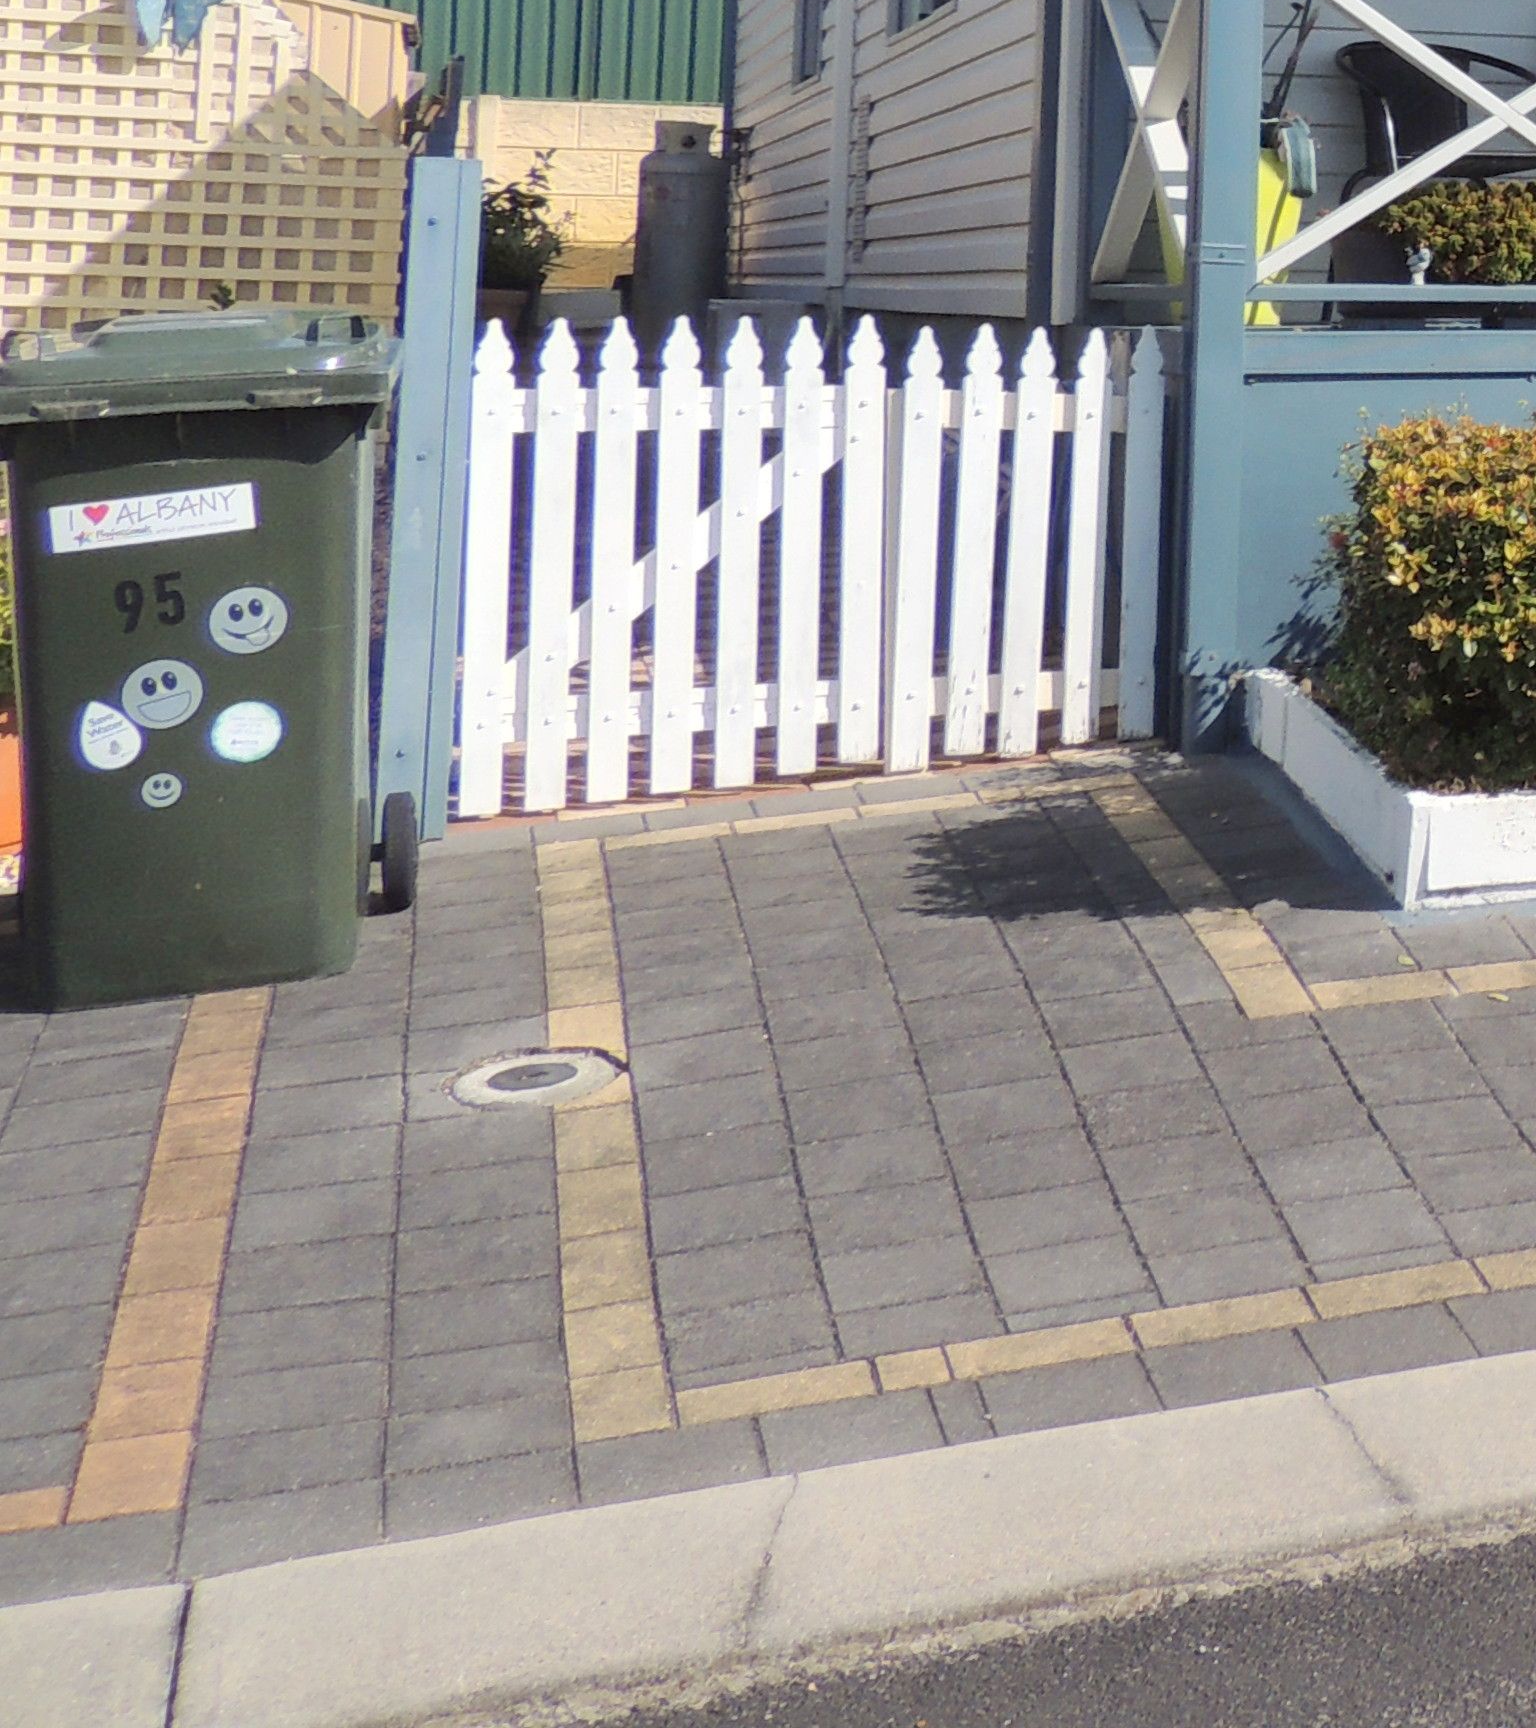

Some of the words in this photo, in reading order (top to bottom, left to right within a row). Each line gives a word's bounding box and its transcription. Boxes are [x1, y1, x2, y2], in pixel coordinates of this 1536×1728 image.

[68, 509, 75, 532] I
[115, 488, 237, 526] ALBANY
[114, 570, 186, 634] 95
